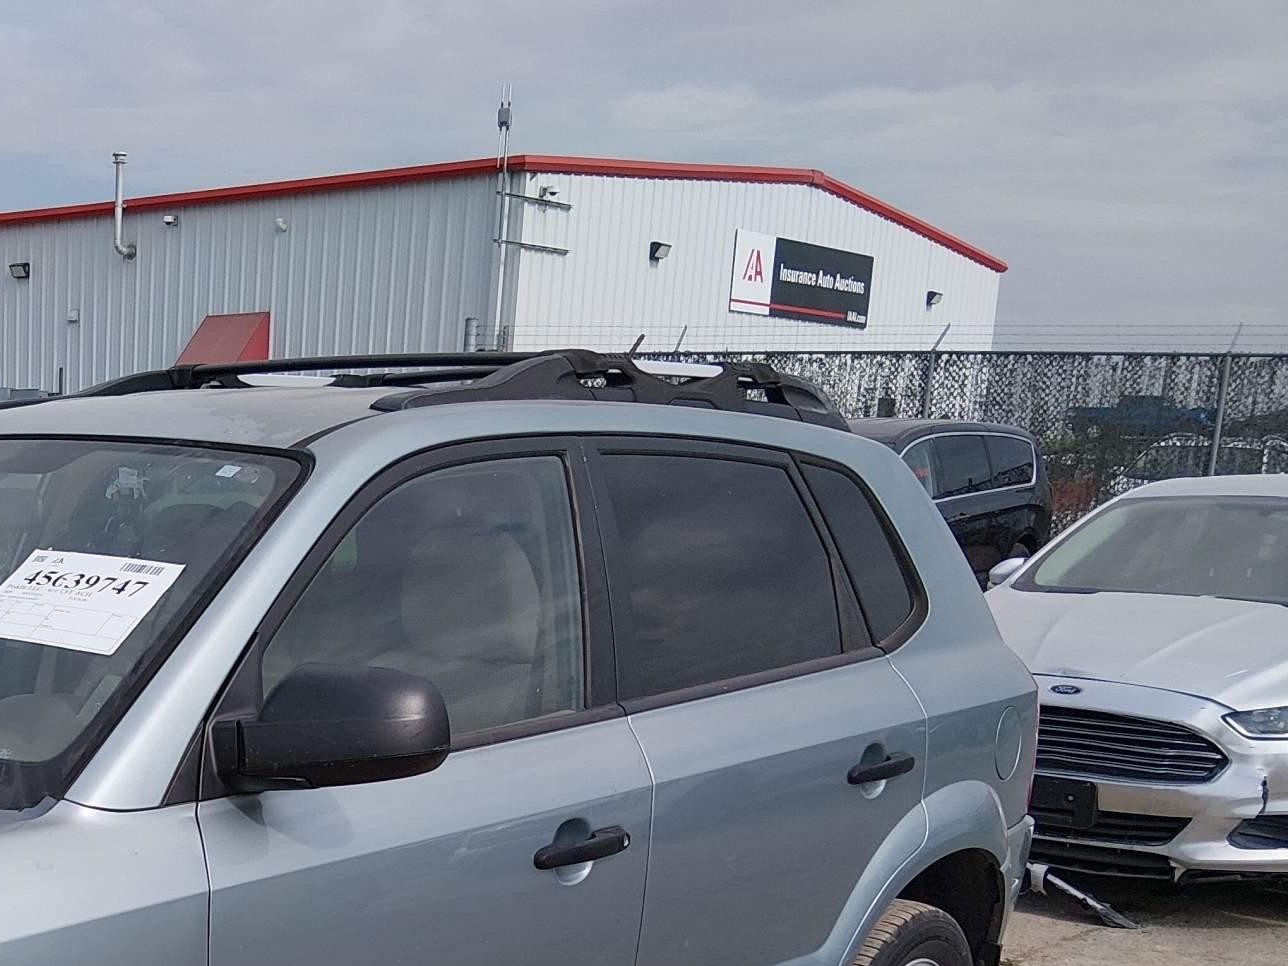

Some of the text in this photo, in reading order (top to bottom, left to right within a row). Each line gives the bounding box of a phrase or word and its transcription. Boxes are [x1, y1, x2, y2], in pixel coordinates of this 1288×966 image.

[779, 263, 865, 295] Insurance Auto Auctions
[24, 569, 150, 597] 45639747
